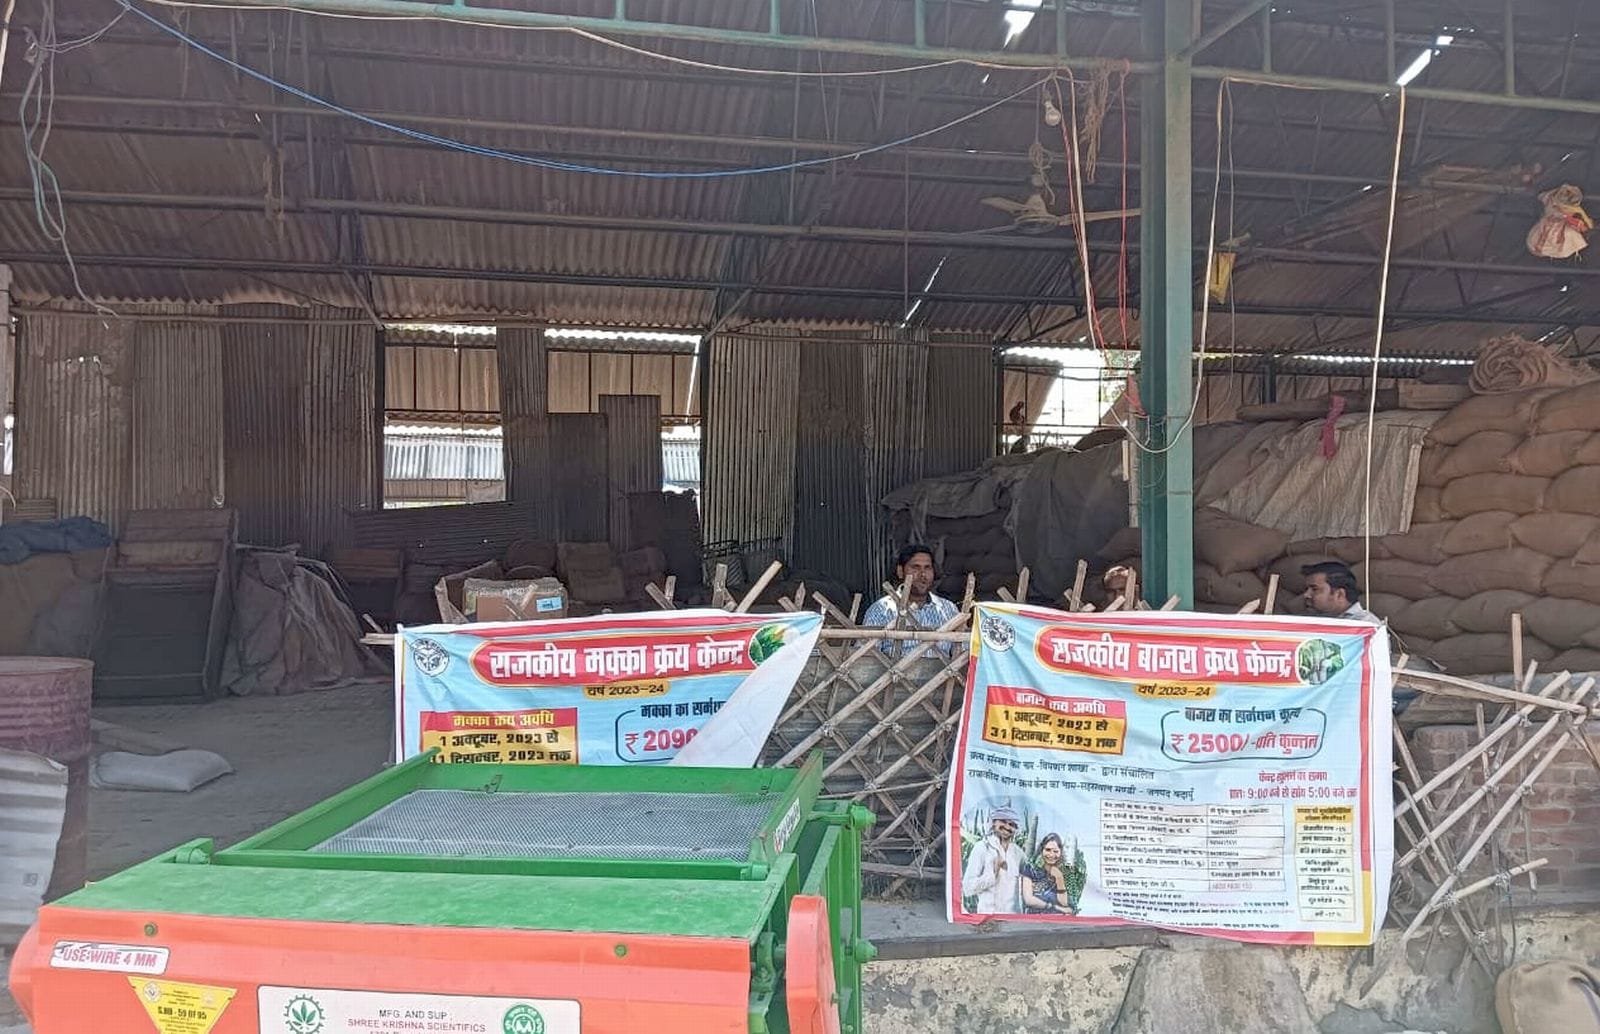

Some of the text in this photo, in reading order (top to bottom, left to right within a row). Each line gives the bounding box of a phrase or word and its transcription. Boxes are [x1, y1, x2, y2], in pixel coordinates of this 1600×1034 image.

[490, 636, 745, 678] राजकीय मक्का क्रय केन्द्र
[1051, 633, 1292, 678] राजकीय बाजरा क्रय केन्द्र
[608, 684, 664, 697] 2023-24
[1158, 684, 1211, 697] 2023-24
[640, 704, 672, 718] मक्का
[674, 702, 689, 717] का
[1218, 708, 1232, 723] का
[519, 711, 554, 726] अवधि
[1003, 710, 1009, 720] 1
[1057, 719, 1092, 731] 2023
[1096, 719, 1109, 731] से
[440, 736, 447, 747] 1
[506, 733, 542, 744] 2023
[546, 730, 559, 744] से
[990, 726, 1006, 739] 31
[1057, 734, 1092, 747] 2023
[1096, 737, 1117, 748] तक
[508, 750, 544, 761] 2023
[549, 750, 571, 761] तक
[1247, 787, 1268, 799] 9:00
[1308, 786, 1330, 799] 5:00
[123, 953, 131, 966] 4
[134, 952, 158, 968] MM
[178, 1007, 187, 1018] 59
[197, 1009, 207, 1020] 95
[405, 1010, 425, 1020] AND
[348, 1018, 380, 1029] SHREE
[382, 1019, 425, 1031] KRISHNA
[427, 1021, 486, 1033] SCIENTIFICS
